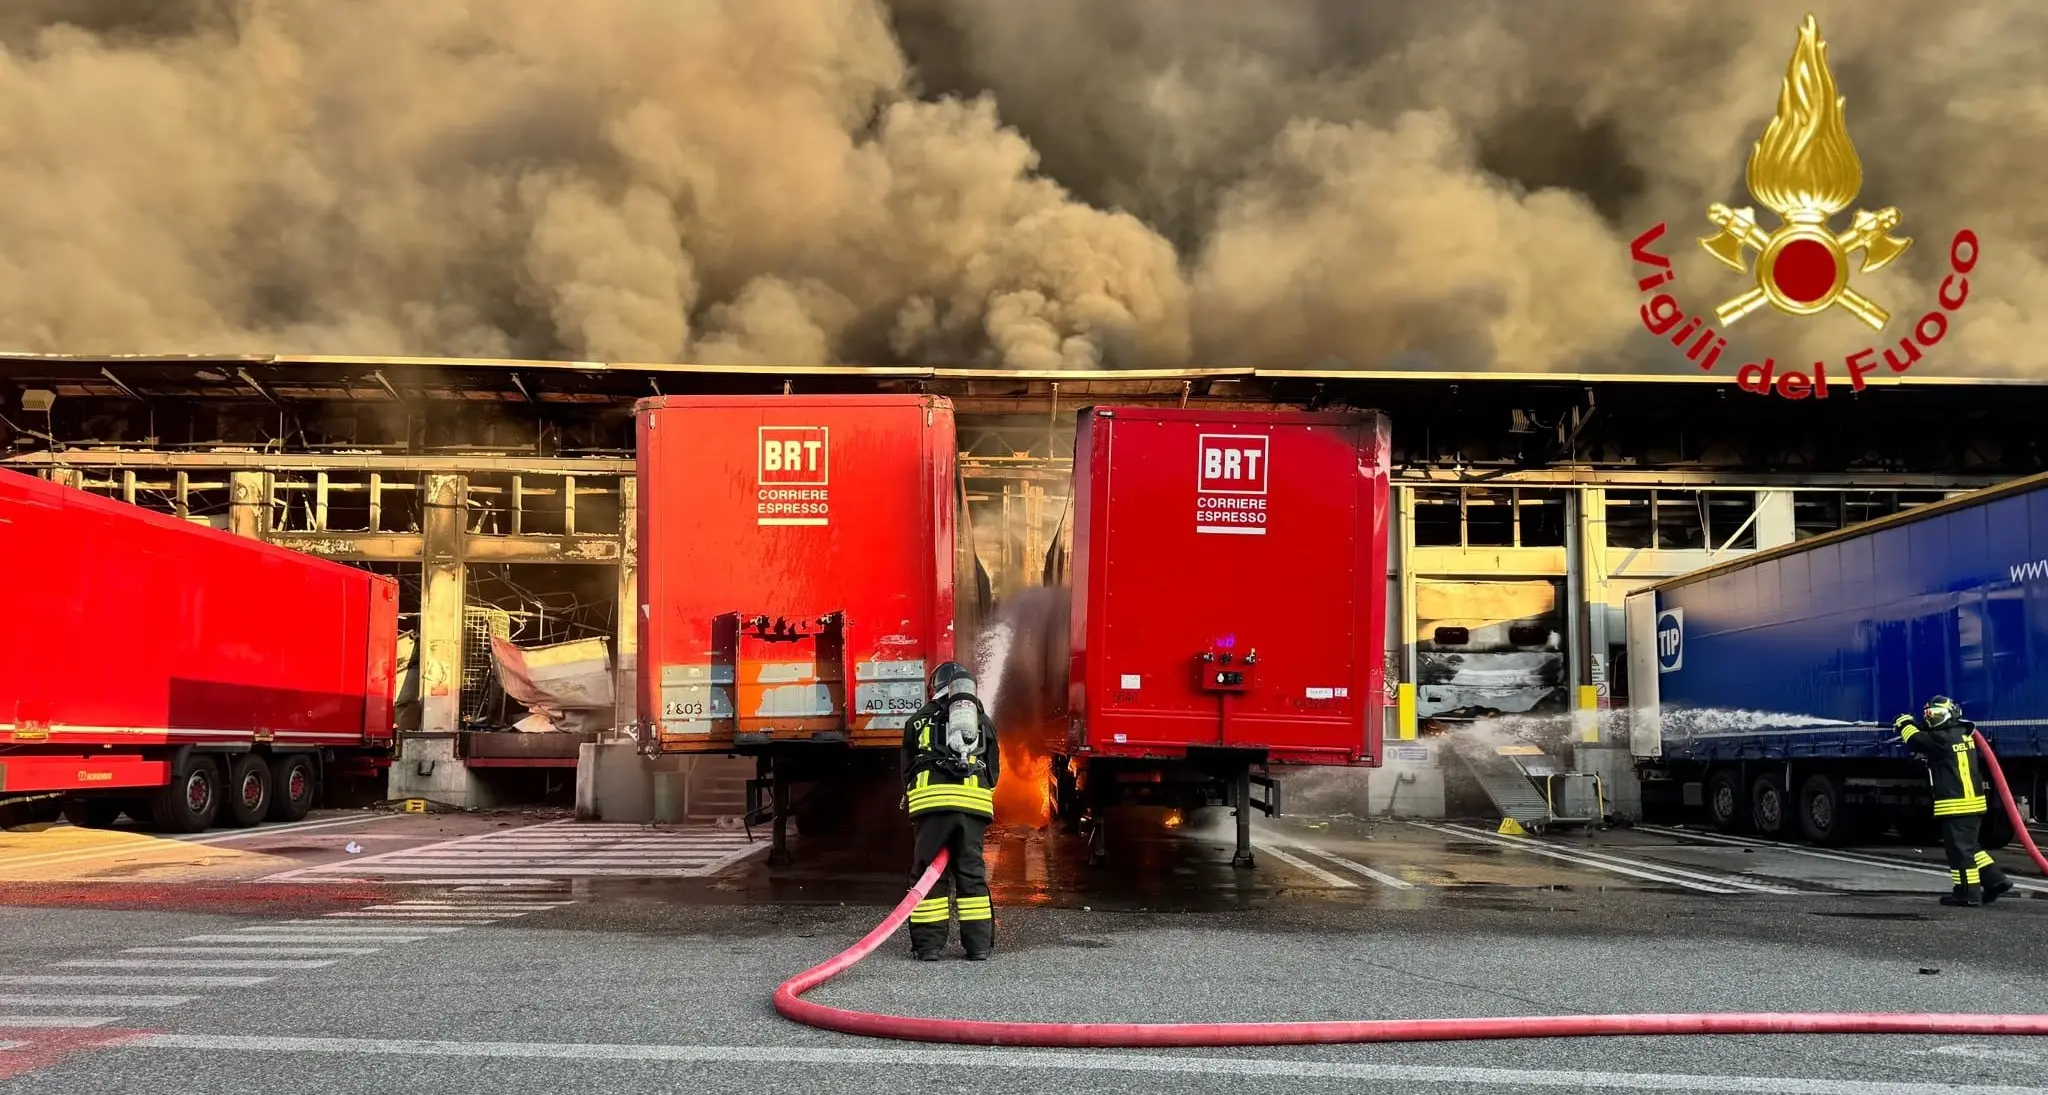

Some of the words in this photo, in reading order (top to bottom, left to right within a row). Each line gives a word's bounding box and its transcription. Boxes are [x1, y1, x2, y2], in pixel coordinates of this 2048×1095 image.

[765, 440, 821, 471] BRT
[1205, 448, 1262, 480] BRT
[758, 489, 828, 500] CORRIERE
[757, 503, 828, 514] ESPRESSO
[1197, 497, 1266, 509] CORRIERE
[1197, 511, 1266, 523] ESPRESSO
[1658, 628, 1680, 657] TIP
[865, 700, 883, 710] AD
[1952, 743, 1968, 752] DEL
